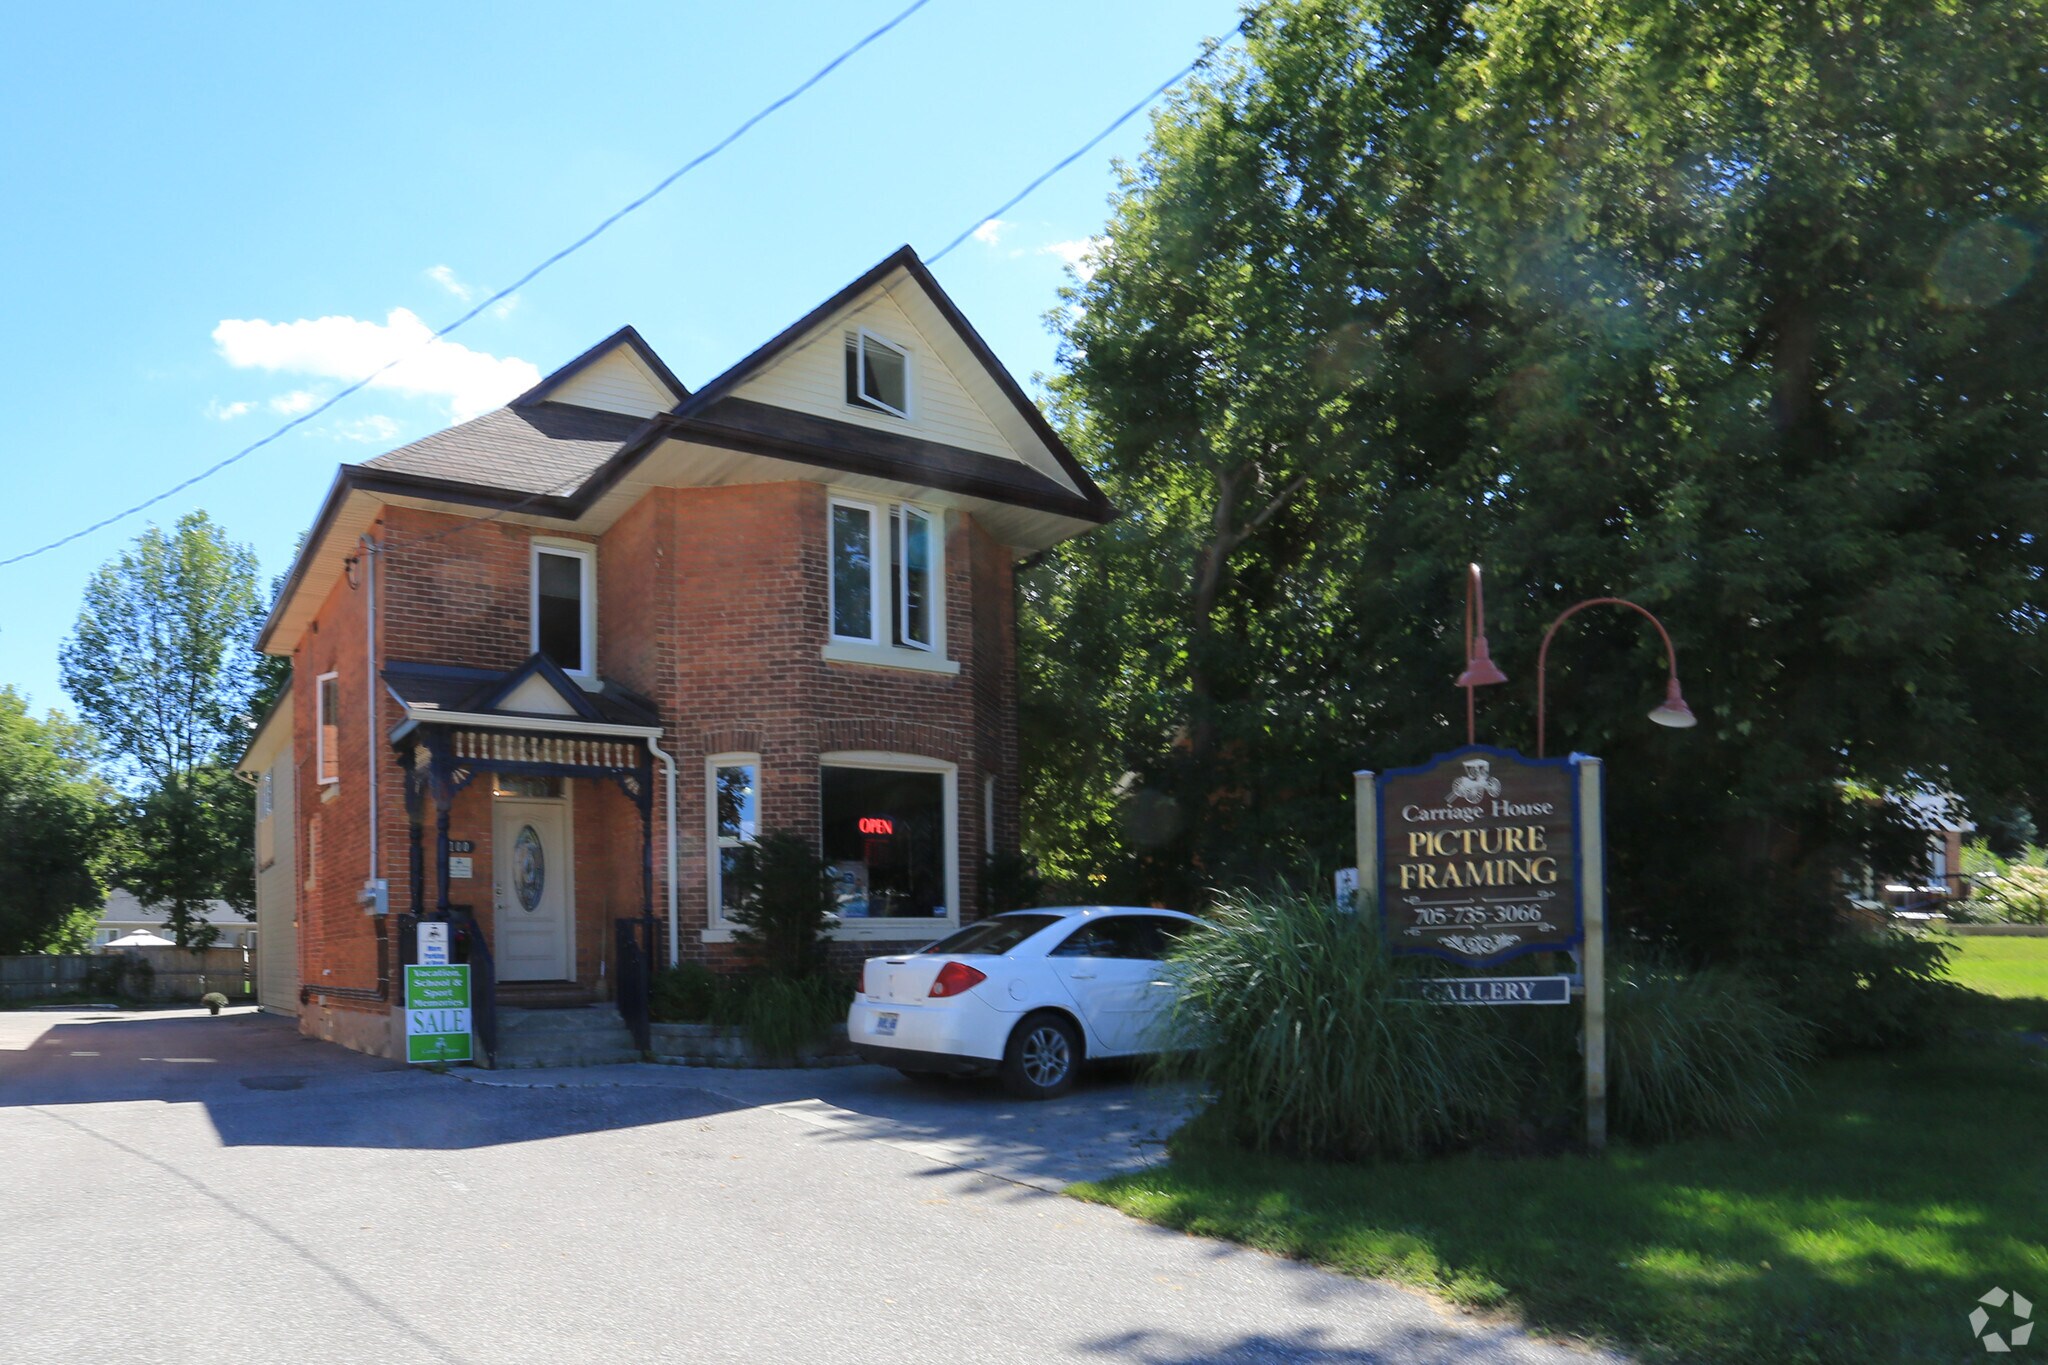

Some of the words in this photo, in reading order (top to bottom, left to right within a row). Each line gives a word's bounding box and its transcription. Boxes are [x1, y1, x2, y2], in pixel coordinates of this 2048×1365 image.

[1402, 804, 1485, 823] Carriage
[1491, 800, 1554, 817] House
[858, 817, 893, 834] OPEN
[1408, 825, 1548, 857] PICTURE
[1400, 856, 1558, 890] FRAMING
[413, 979, 450, 988] School
[452, 979, 463, 987] &
[413, 999, 464, 1008] Memories
[423, 989, 453, 999] Sport
[413, 1010, 465, 1034] SALE
